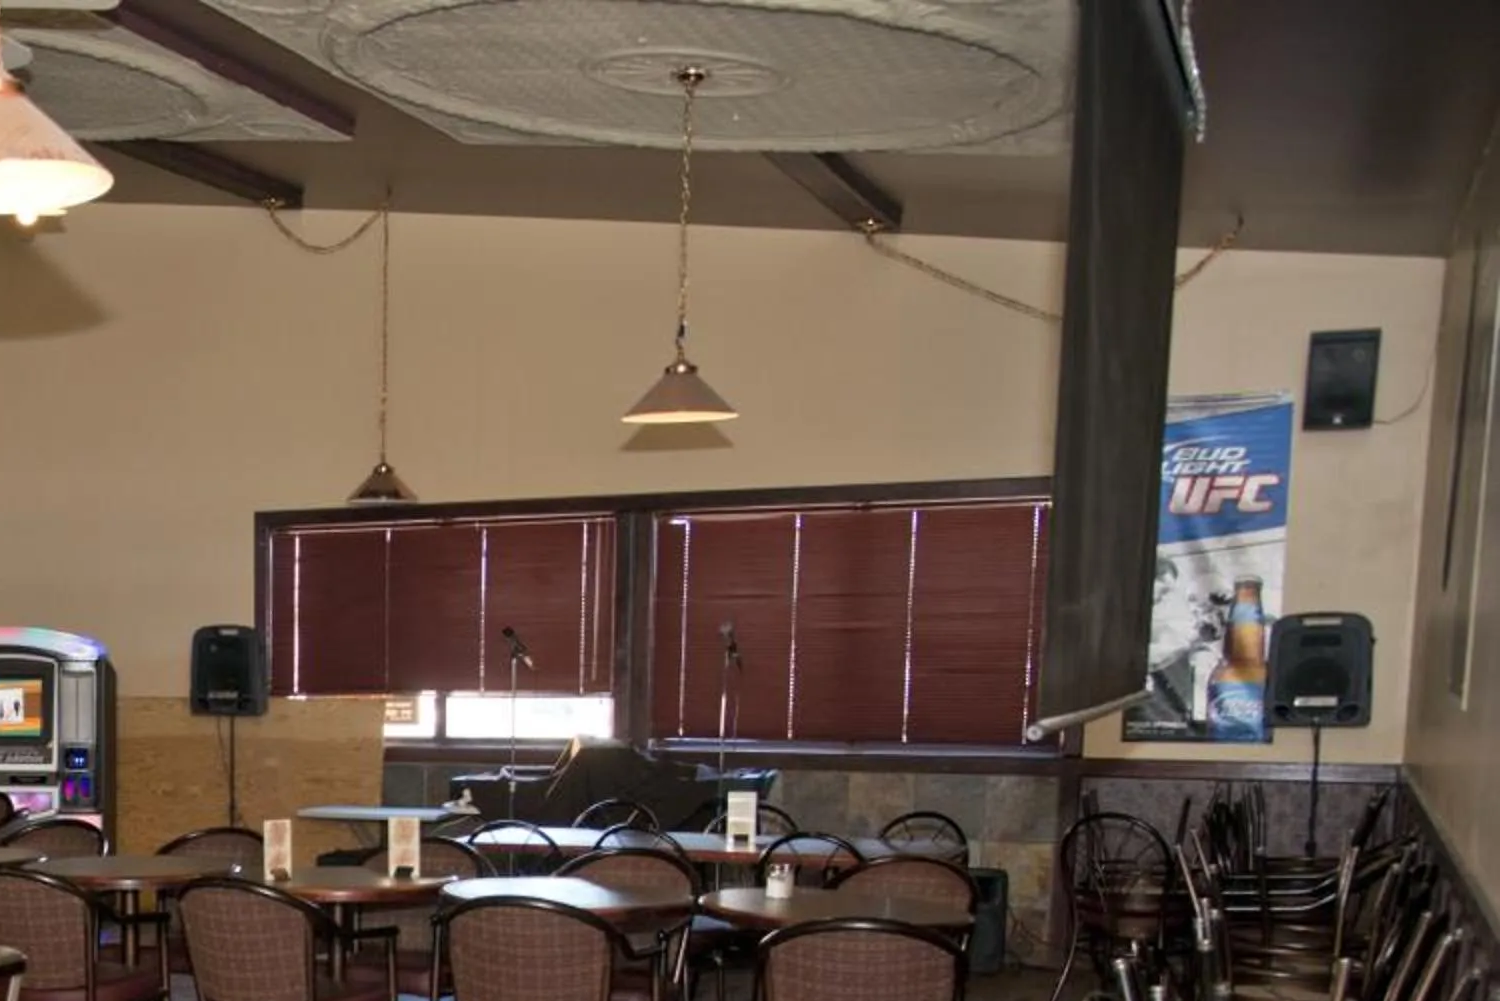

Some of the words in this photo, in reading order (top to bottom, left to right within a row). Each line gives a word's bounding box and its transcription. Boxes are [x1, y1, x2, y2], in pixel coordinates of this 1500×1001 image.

[1172, 447, 1247, 461] BUD
[1162, 460, 1251, 474] LIGHT
[1169, 474, 1280, 514] UFC
